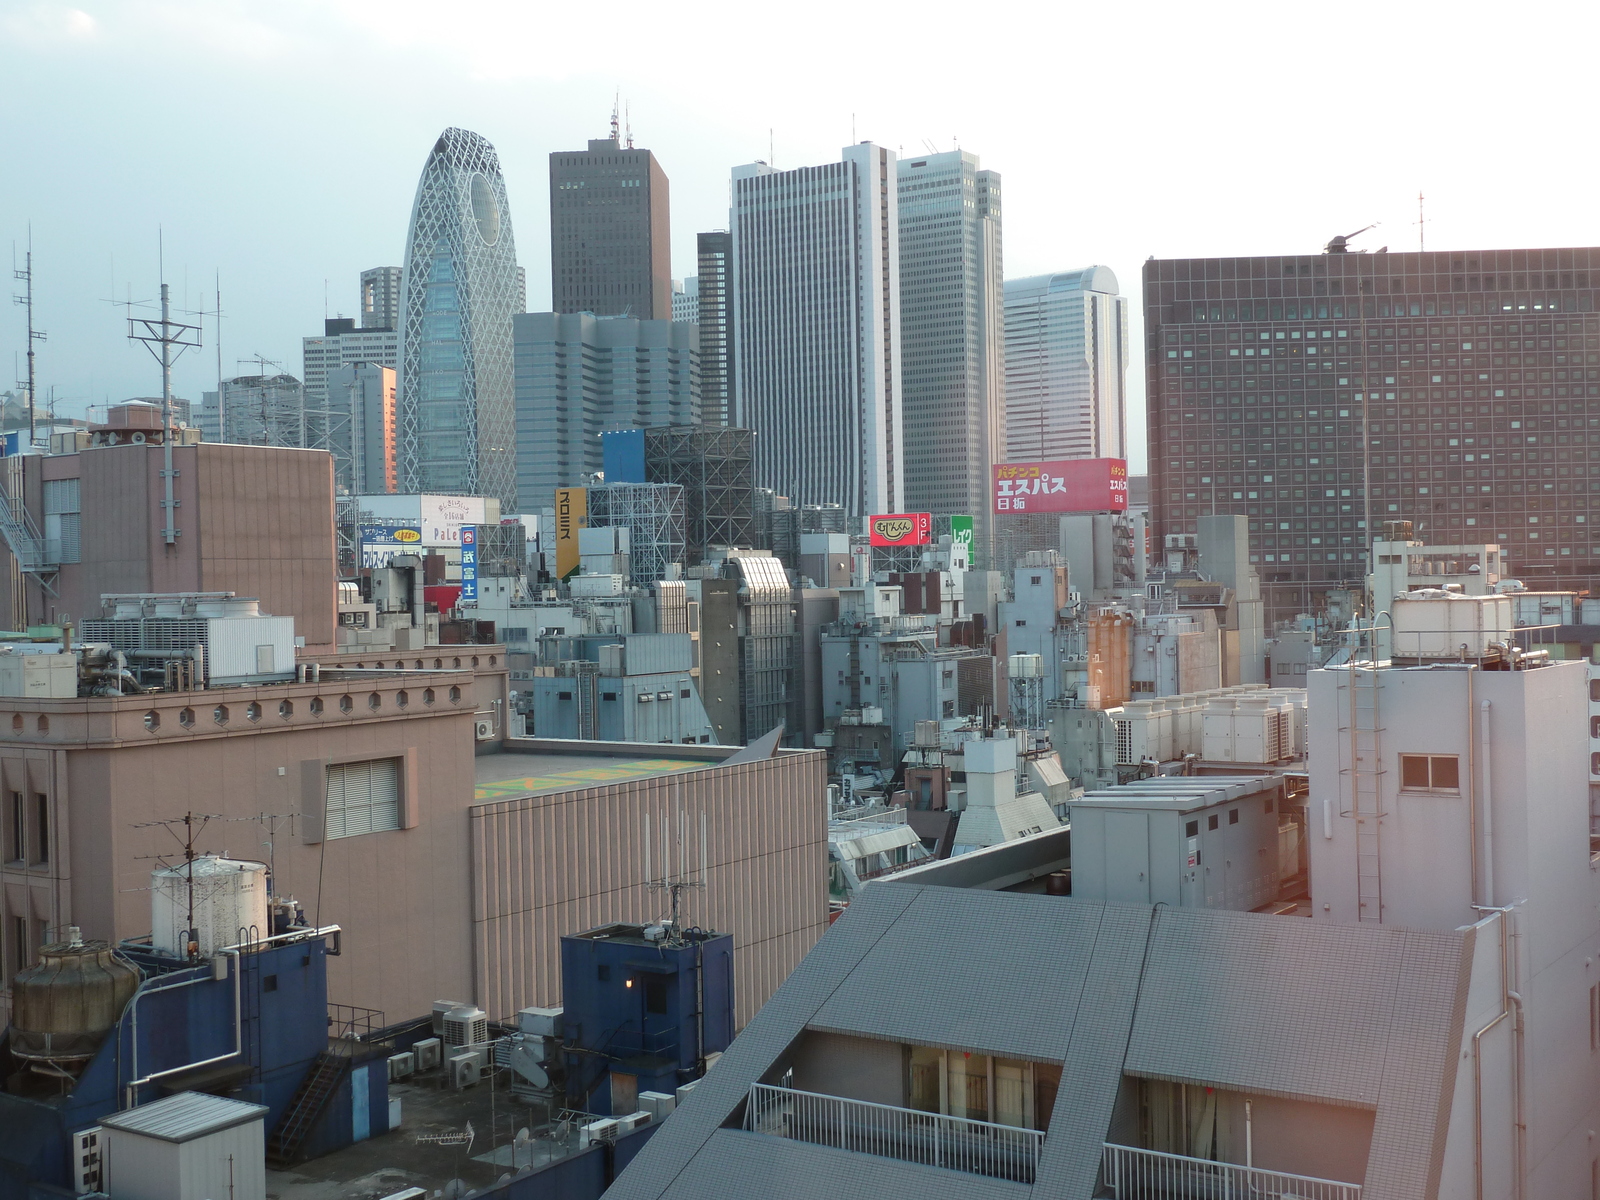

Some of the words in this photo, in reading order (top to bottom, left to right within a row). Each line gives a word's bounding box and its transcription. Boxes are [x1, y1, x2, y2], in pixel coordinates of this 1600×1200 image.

[997, 466, 1040, 478] パチンコ
[997, 474, 1067, 497] エスパス
[1109, 479, 1128, 491] エスパス
[560, 492, 570, 539] プロミス
[876, 522, 911, 538] むじんくん
[953, 528, 972, 544] レイク
[463, 550, 475, 596] 武富士
